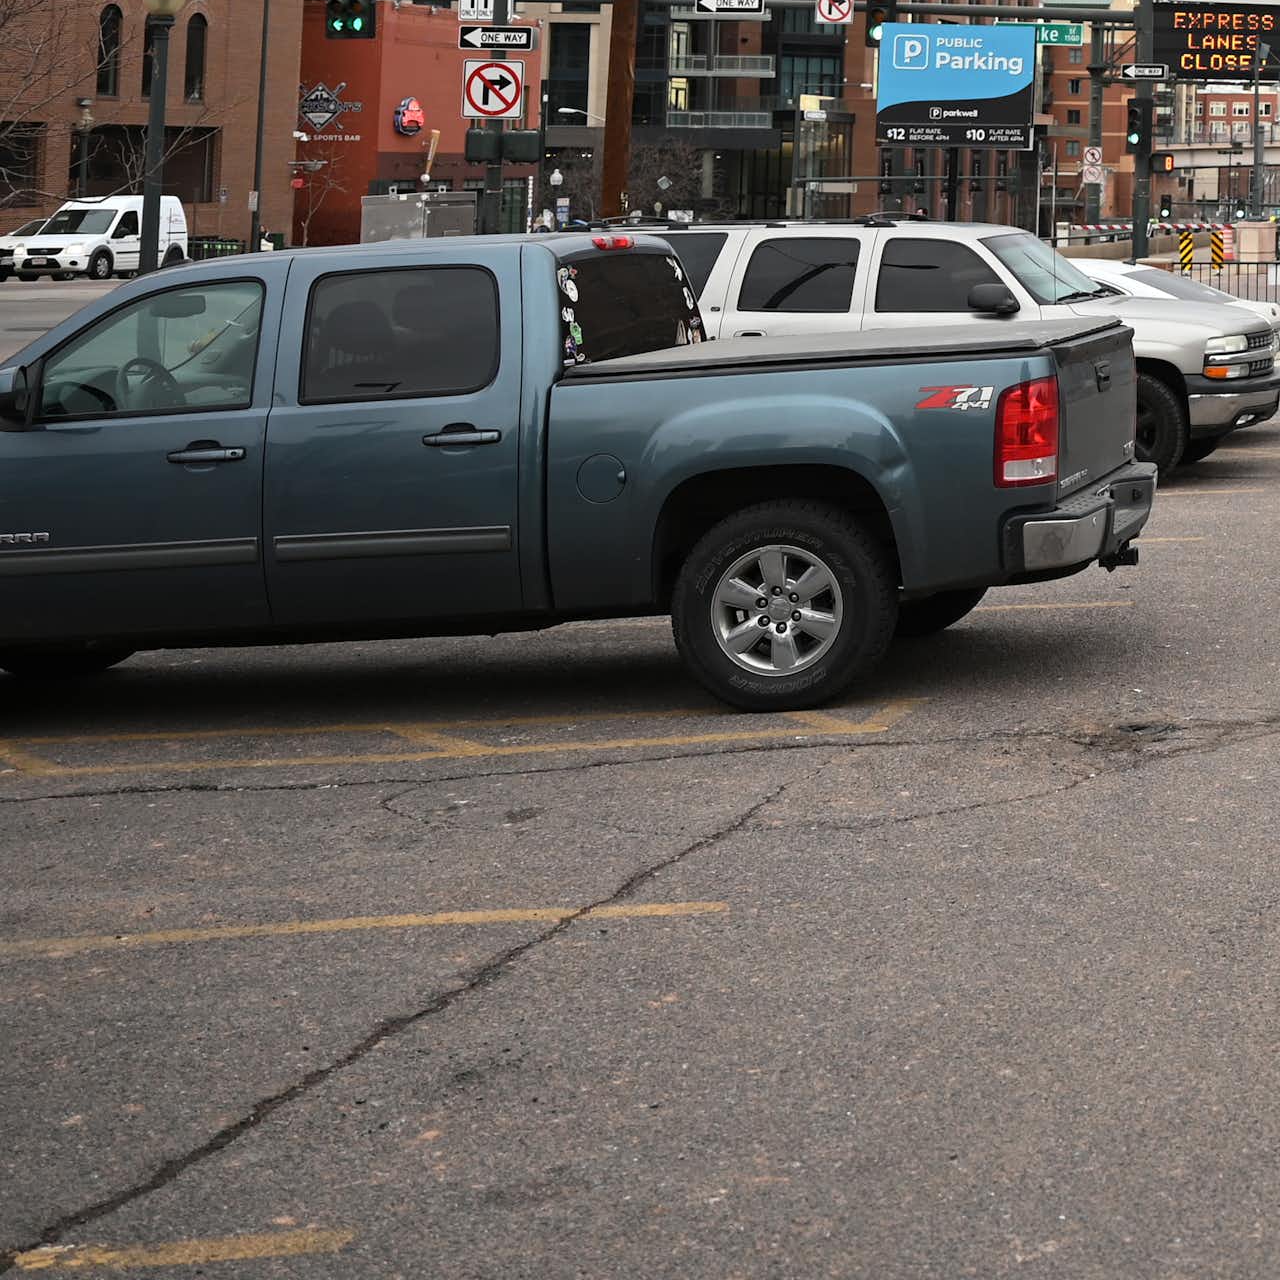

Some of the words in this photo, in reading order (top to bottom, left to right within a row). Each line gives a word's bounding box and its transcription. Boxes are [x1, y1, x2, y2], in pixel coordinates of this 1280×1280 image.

[1173, 12, 1274, 30] EXPRESS
[481, 33, 501, 42] ONE
[504, 33, 524, 42] WAY
[1037, 26, 1059, 41] ke
[936, 38, 983, 49] PUBLIC
[1188, 33, 1260, 51] LANES
[935, 51, 1023, 75] Parking
[943, 109, 978, 119] parkwell
[887, 127, 906, 140] $12
[966, 128, 985, 141] $10
[915, 384, 995, 410] Z71
